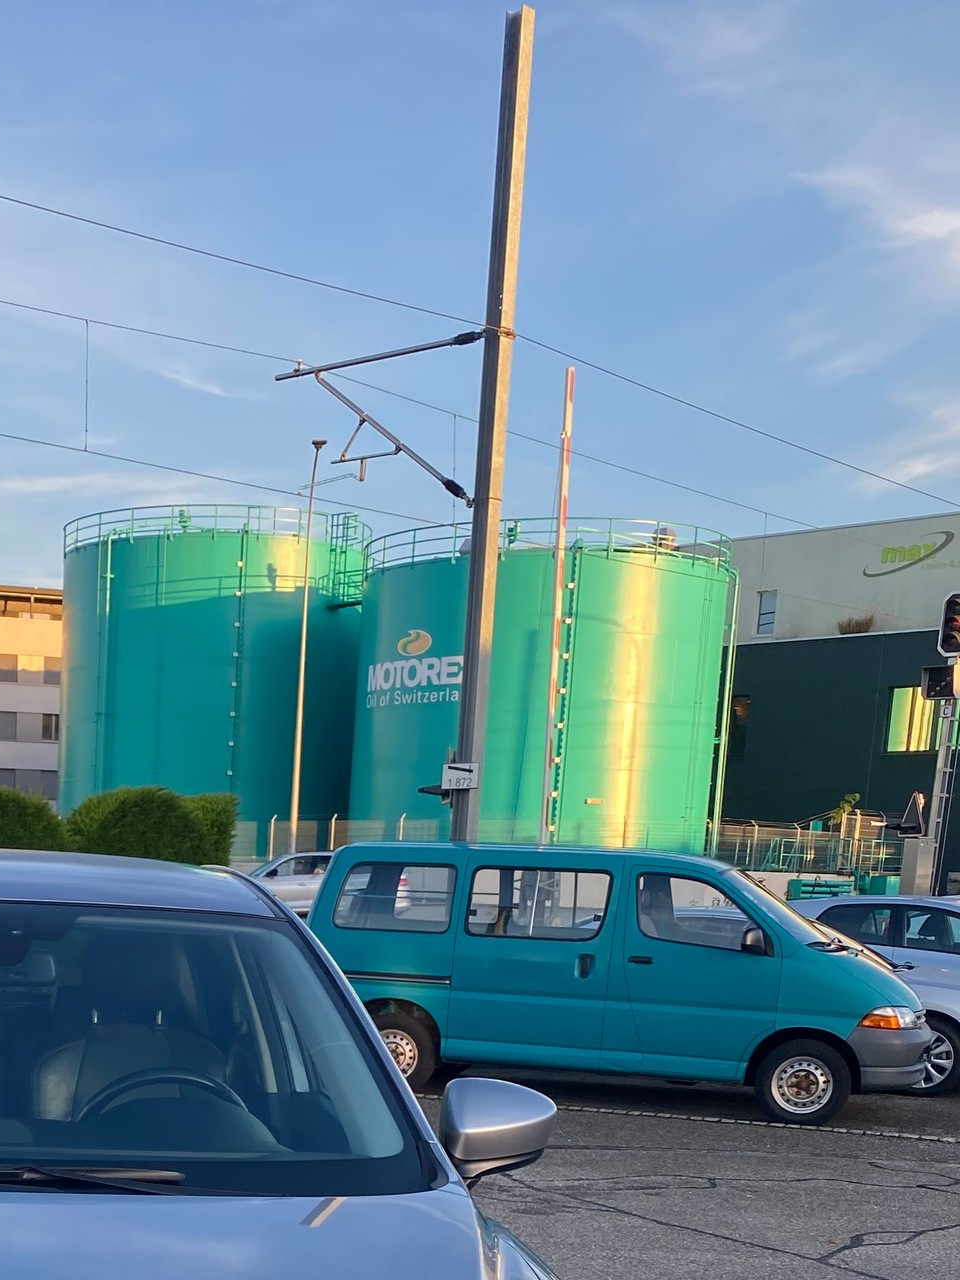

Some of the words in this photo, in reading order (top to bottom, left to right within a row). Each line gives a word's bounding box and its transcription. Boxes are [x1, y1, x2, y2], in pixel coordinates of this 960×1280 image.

[366, 694, 377, 708] Oil
[380, 691, 391, 706] of
[394, 687, 459, 705] Switzerla
[943, 706, 949, 715] C
